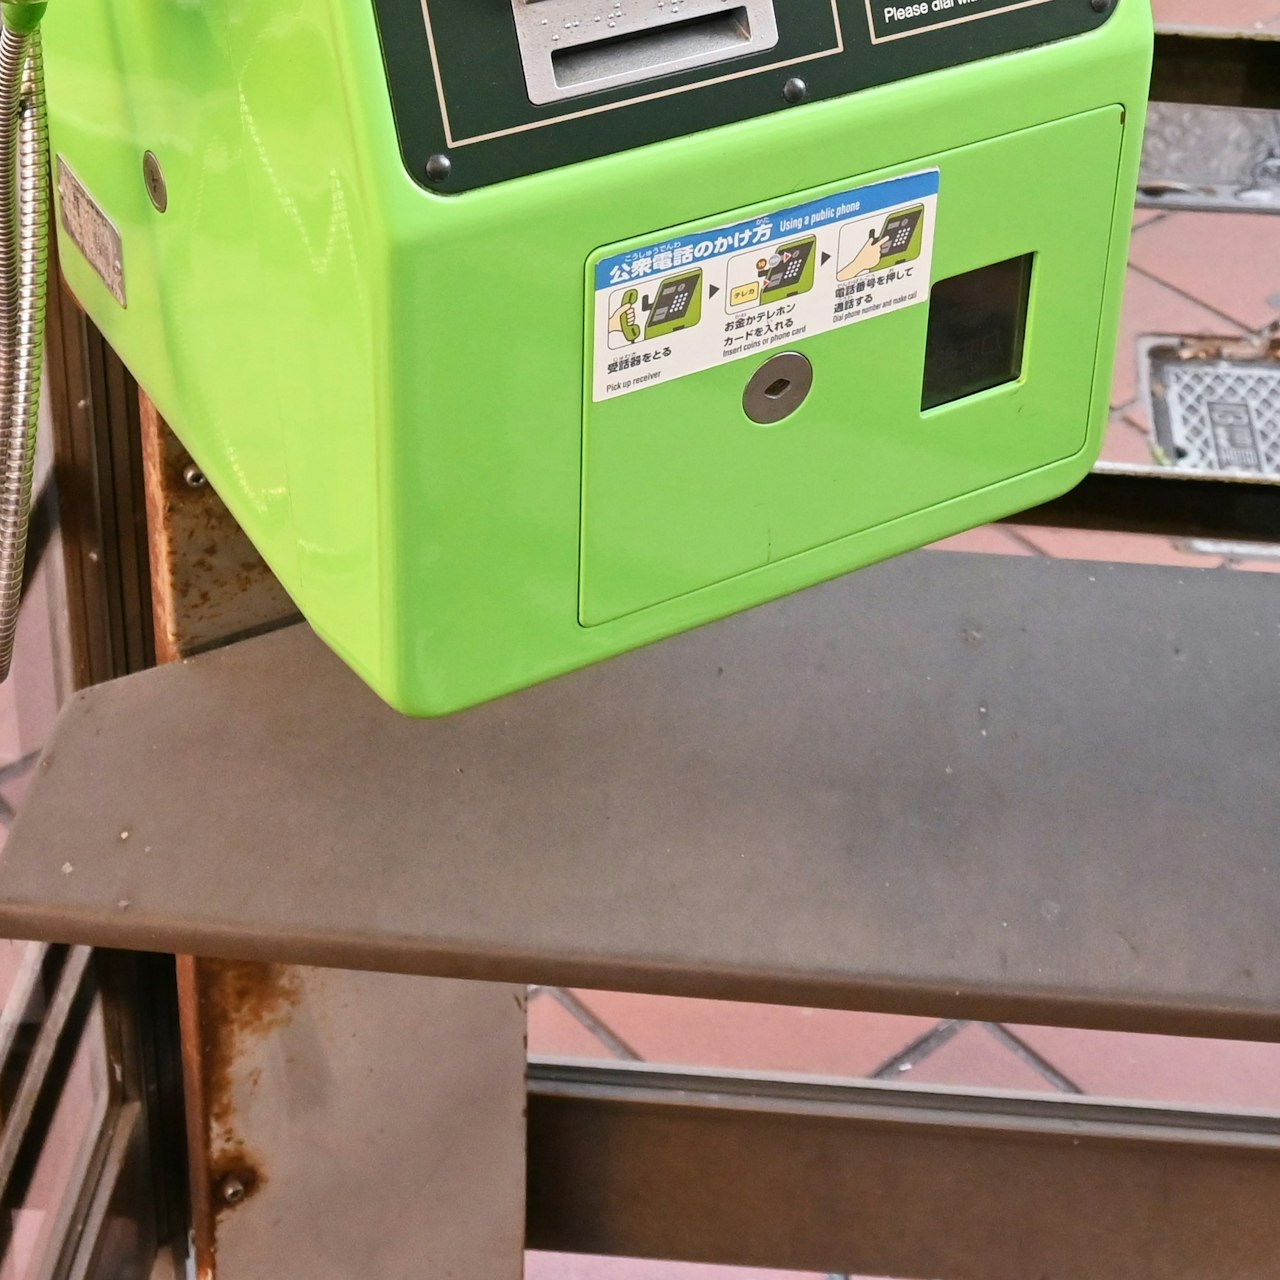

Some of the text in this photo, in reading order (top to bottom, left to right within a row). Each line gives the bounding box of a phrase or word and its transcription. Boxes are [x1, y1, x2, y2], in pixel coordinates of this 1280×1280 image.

[883, 3, 929, 23] Please
[780, 200, 860, 232] Using a public phone
[609, 223, 773, 284] 公衆電話のかけ方
[734, 288, 756, 299] テレカ
[834, 266, 914, 298] 電話番号を押して
[724, 303, 796, 332] お金かテレホン
[832, 290, 918, 323] Dial phone number and make call
[833, 293, 873, 314] 通話する
[722, 324, 807, 357] Insert coins or phone card
[723, 317, 794, 347] カードを入れる
[607, 346, 672, 375] 受話器をとる
[606, 371, 662, 393] Pick up receiver
